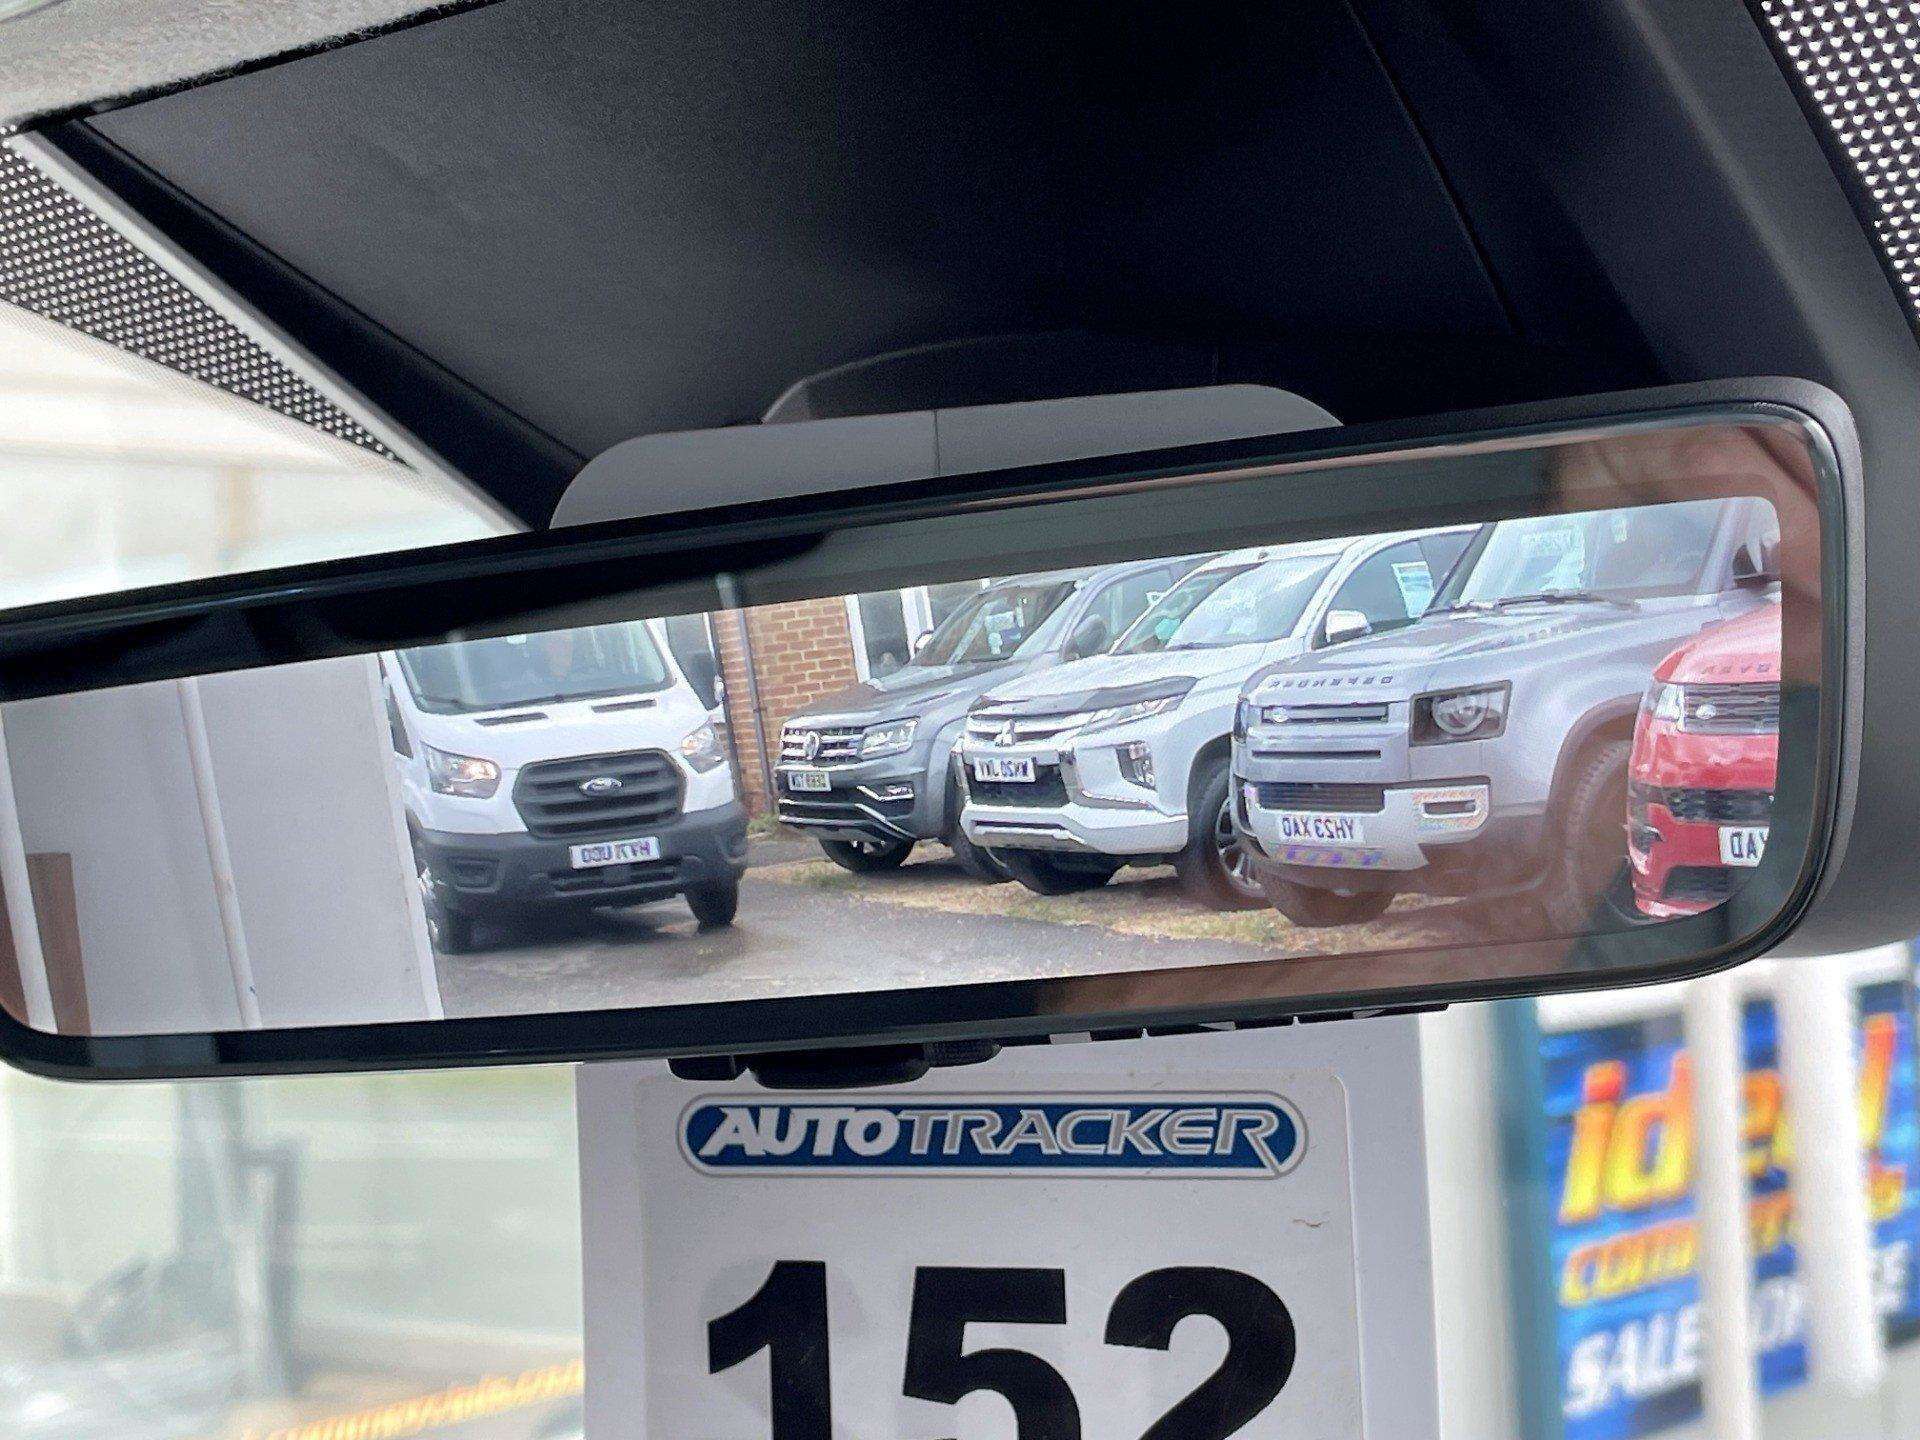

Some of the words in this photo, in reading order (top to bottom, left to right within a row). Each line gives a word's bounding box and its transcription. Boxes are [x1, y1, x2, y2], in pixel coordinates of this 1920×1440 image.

[702, 1106, 1282, 1166] AUTOTRACKER
[707, 1259, 1298, 1440] 152
[1562, 1304, 1704, 1420] SALE
